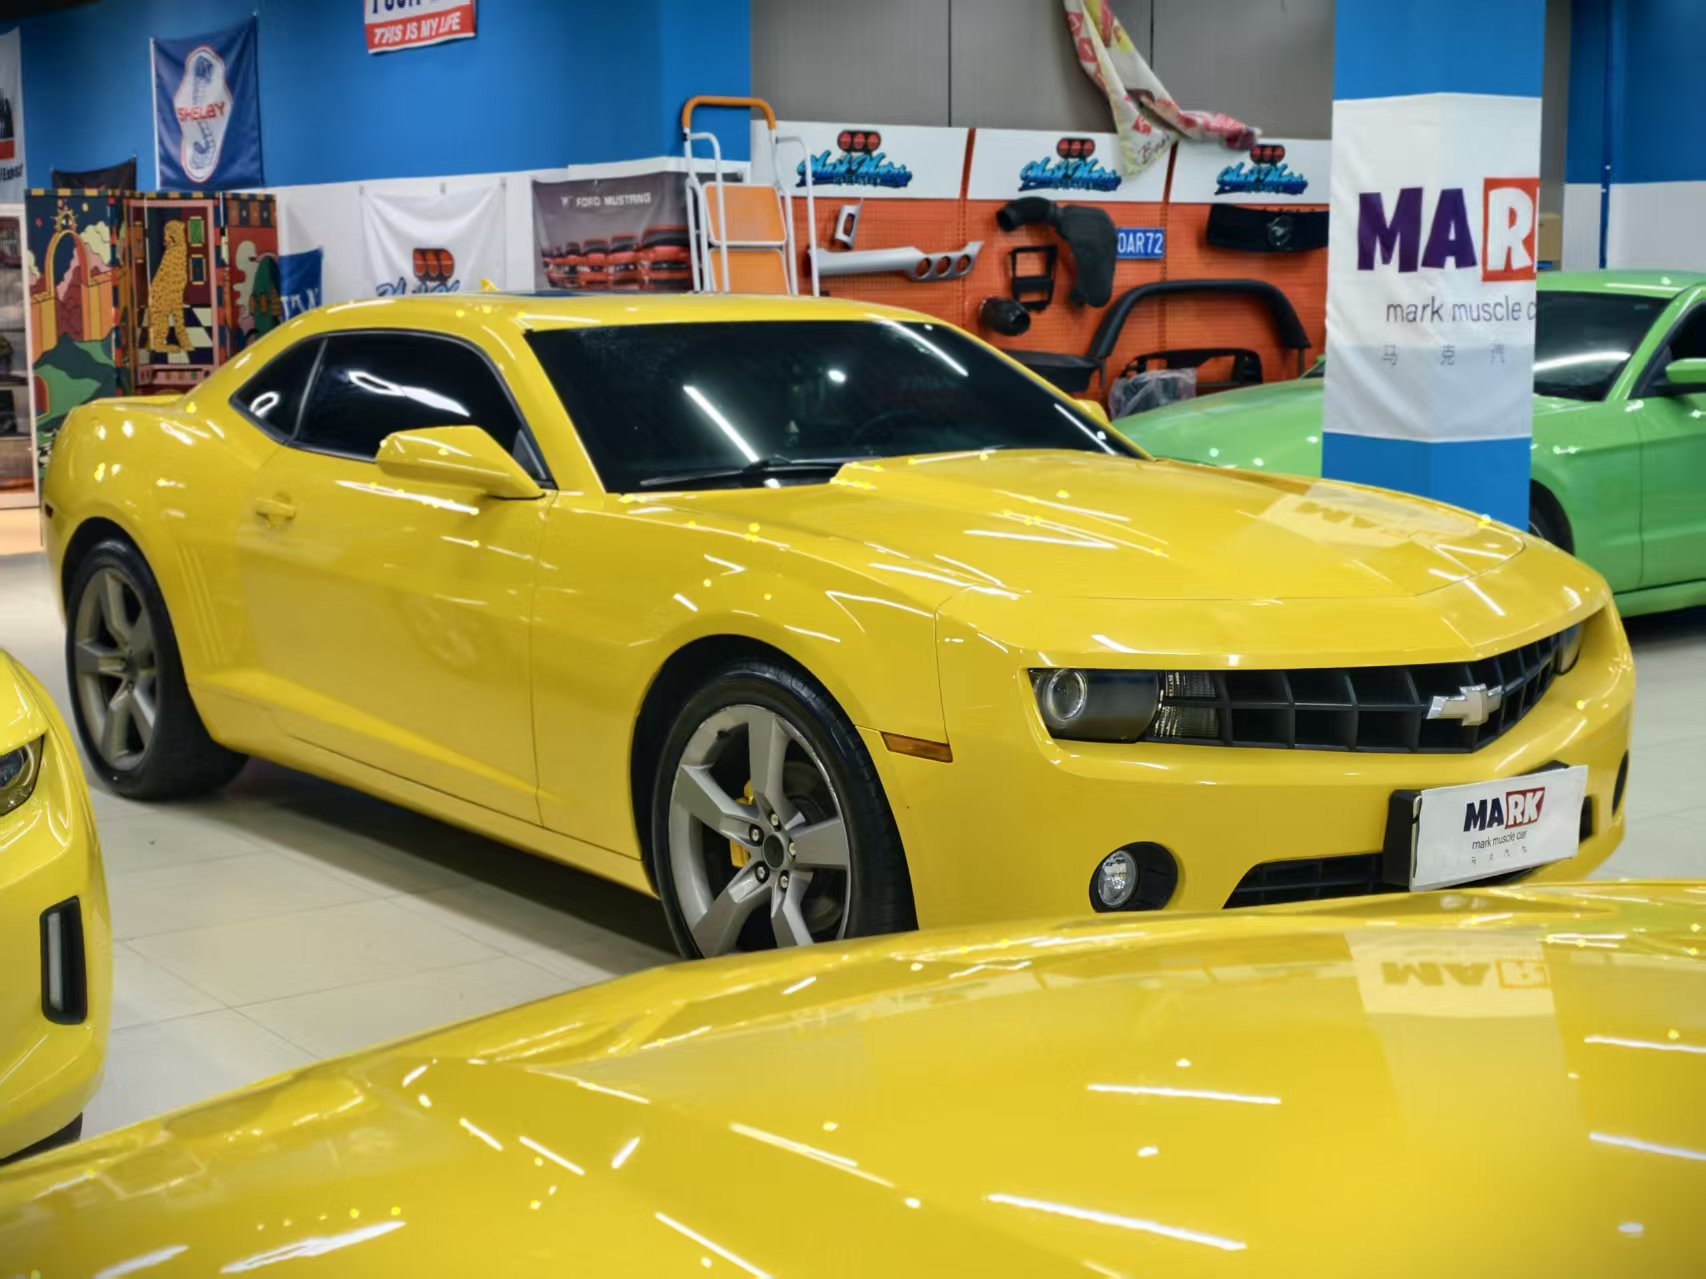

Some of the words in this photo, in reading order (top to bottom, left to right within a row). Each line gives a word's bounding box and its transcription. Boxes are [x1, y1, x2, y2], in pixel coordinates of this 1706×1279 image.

[374, 24, 404, 44] THIS
[405, 21, 418, 40] IS
[420, 17, 439, 38] MY
[439, 11, 461, 34] LIFE
[176, 101, 226, 122] SHELBY
[576, 195, 600, 207] FORD
[603, 191, 652, 206] MUSTANG
[1357, 186, 1540, 274] MAR
[1386, 296, 1444, 323] mark
[1452, 295, 1522, 322] muscle
[1463, 788, 1545, 832] MARK
[1472, 836, 1492, 850] mark
[1492, 831, 1516, 847] muscle
[1516, 829, 1528, 840] car
